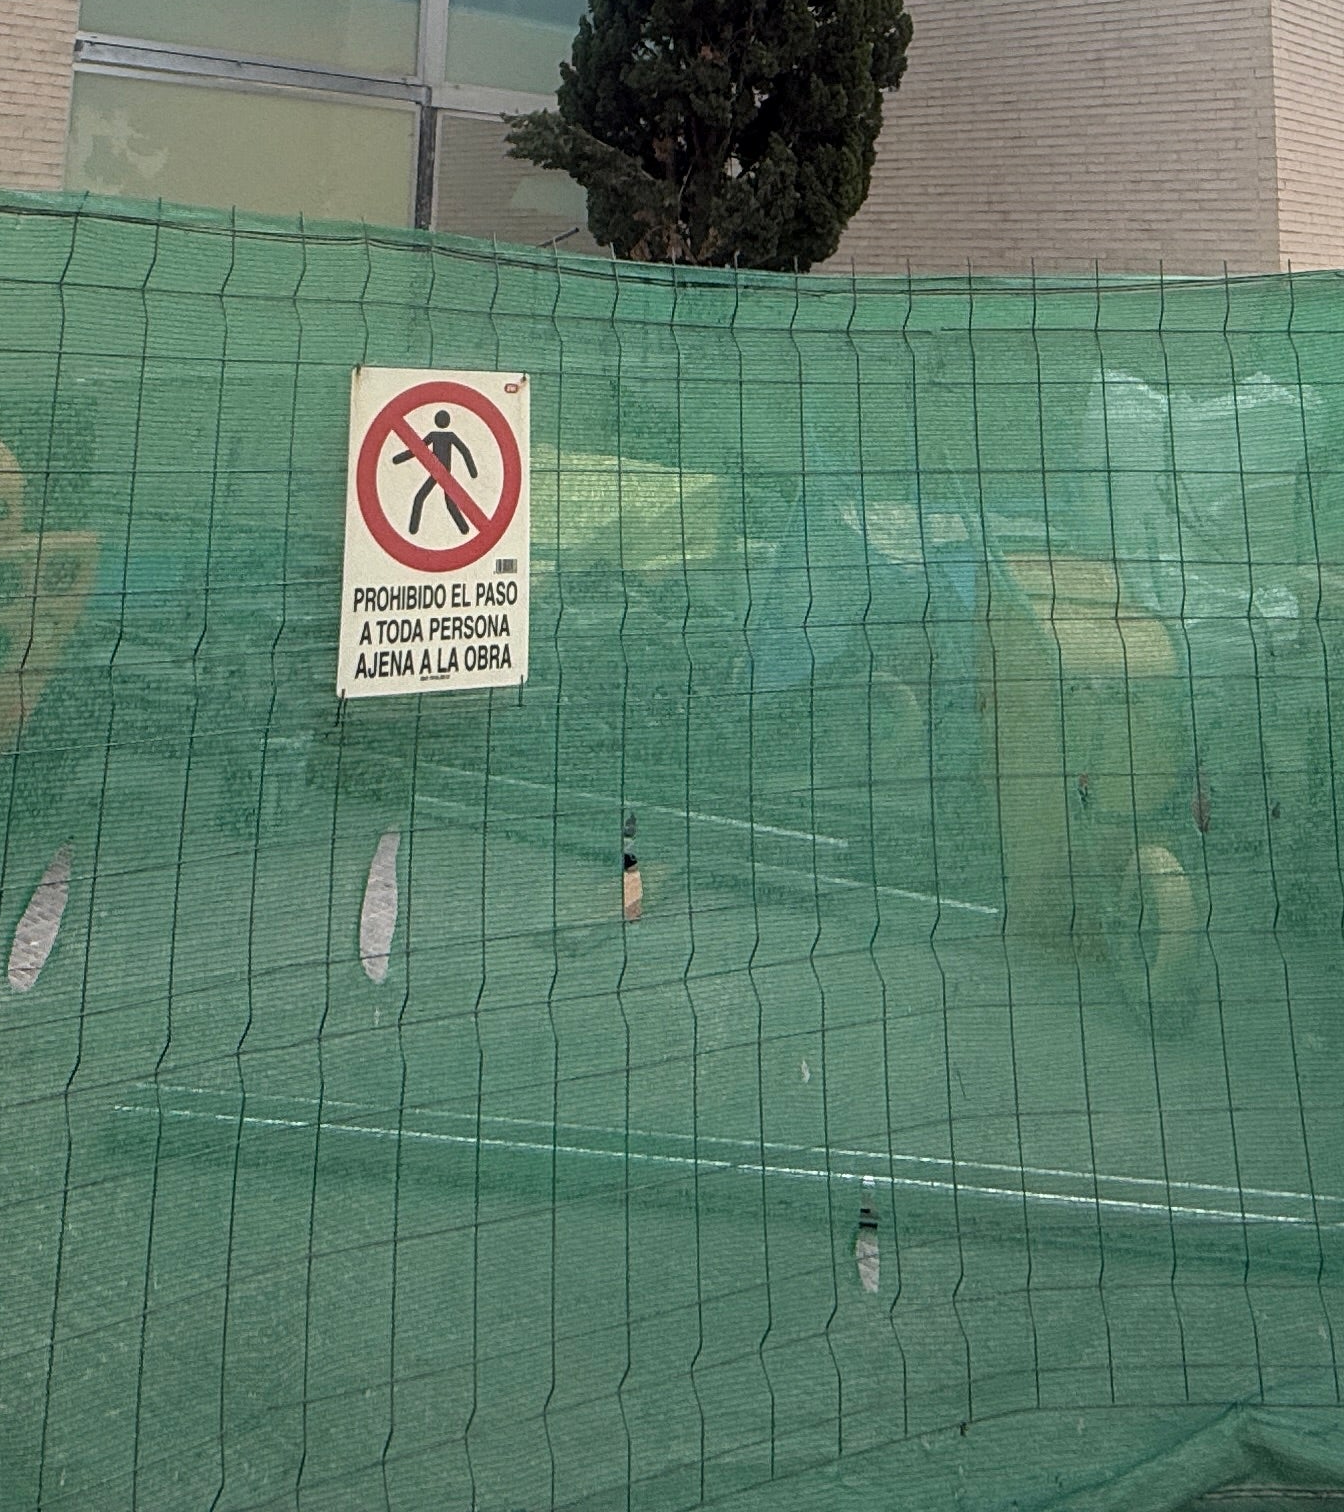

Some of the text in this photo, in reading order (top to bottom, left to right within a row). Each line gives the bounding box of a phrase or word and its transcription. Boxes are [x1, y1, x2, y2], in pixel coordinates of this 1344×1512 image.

[354, 581, 518, 612] PROHIBIDO EL PASO
[359, 614, 511, 645] A TODA PERSONA
[354, 643, 512, 679] AJENA A LA OBRA
